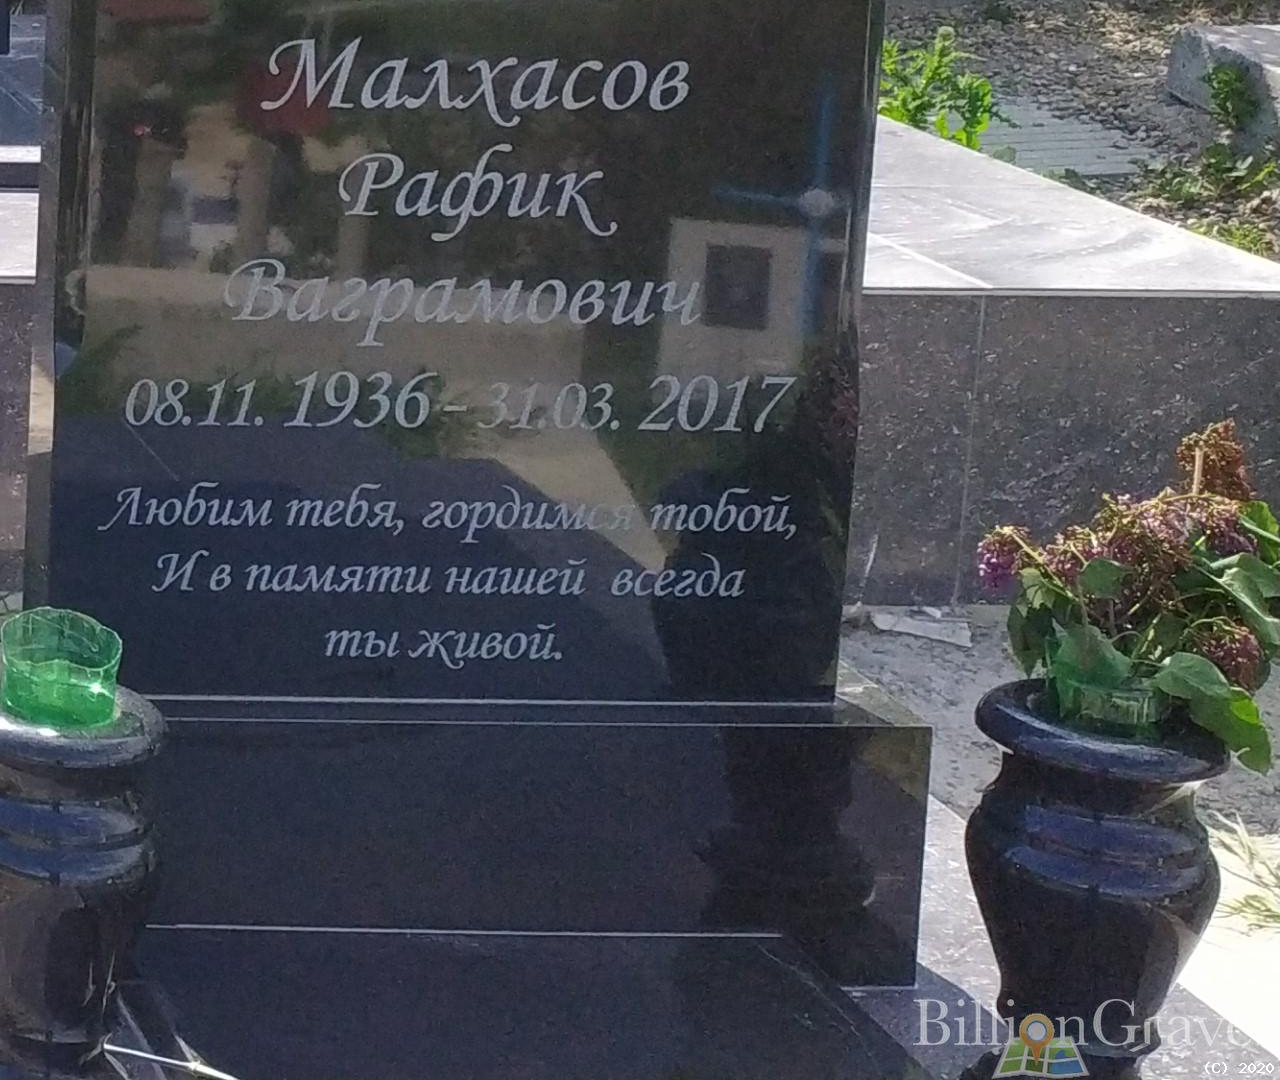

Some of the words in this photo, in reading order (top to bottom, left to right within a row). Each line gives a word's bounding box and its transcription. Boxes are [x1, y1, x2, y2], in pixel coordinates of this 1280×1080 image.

[260, 35, 691, 127] Малхасов
[339, 144, 617, 241] Рафик
[224, 258, 703, 347] Ваграмович
[283, 370, 439, 429] 1936
[637, 373, 798, 434] 2017
[96, 480, 274, 531] Любим
[285, 482, 406, 537] тебя,
[420, 483, 632, 544] гордимся
[649, 487, 798, 540] тобой,
[151, 551, 208, 593] И
[208, 564, 231, 592] в
[245, 561, 431, 595] памяти
[444, 556, 586, 596] нашей
[609, 553, 746, 599] всегда
[324, 626, 399, 660] ты
[407, 624, 564, 669] живой.
